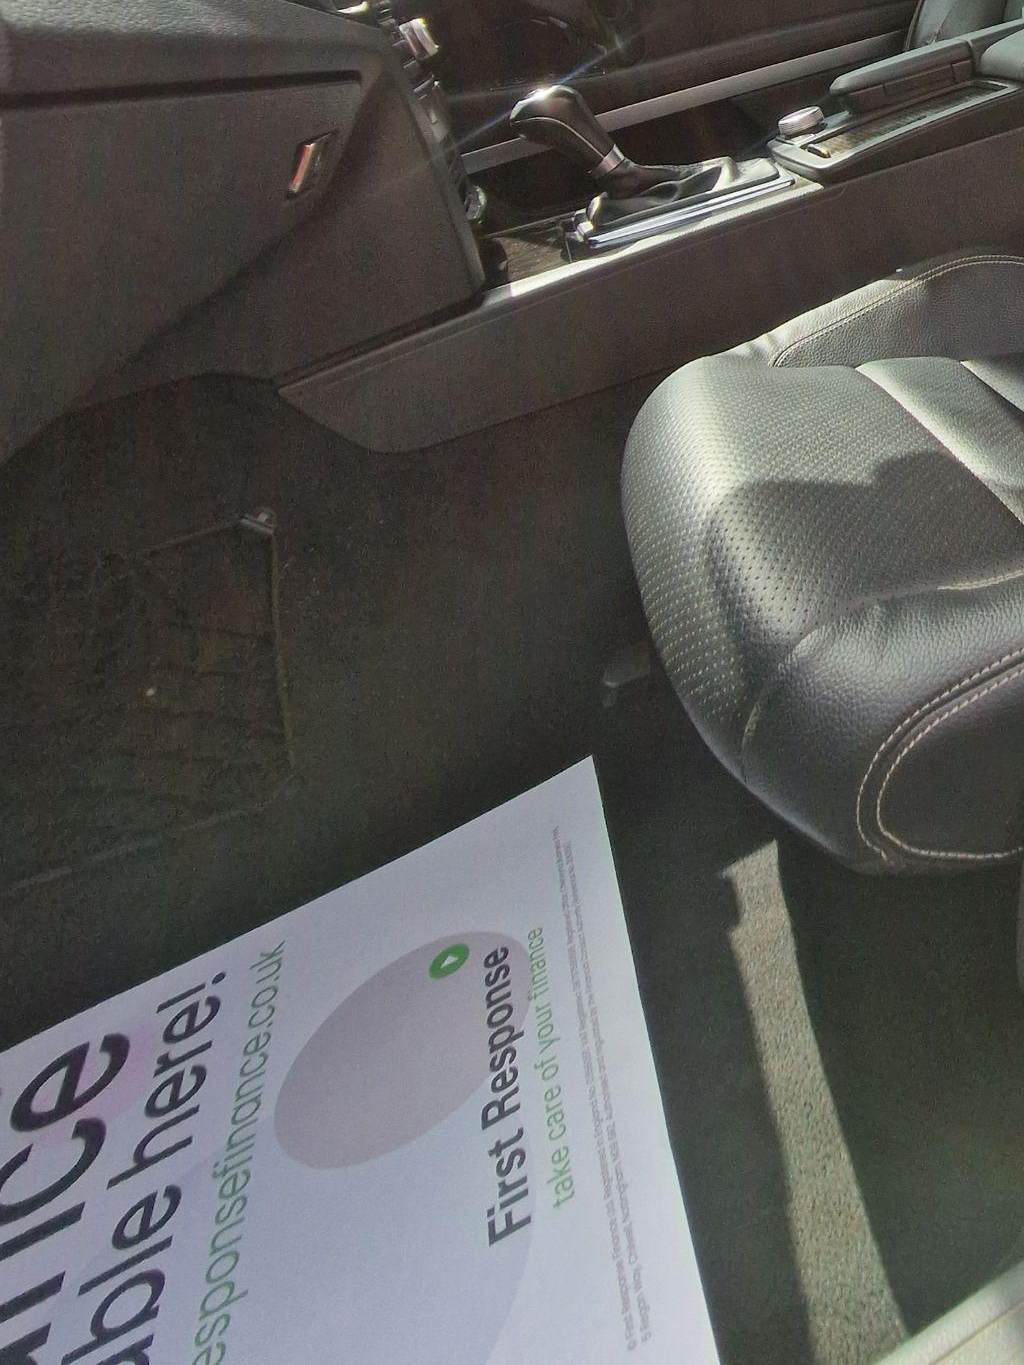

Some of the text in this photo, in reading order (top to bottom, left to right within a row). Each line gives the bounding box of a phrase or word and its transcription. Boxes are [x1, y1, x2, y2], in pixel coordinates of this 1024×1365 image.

[106, 971, 226, 1190] here!
[481, 946, 532, 1246] First Response
[527, 926, 575, 1210] take care of your finance
